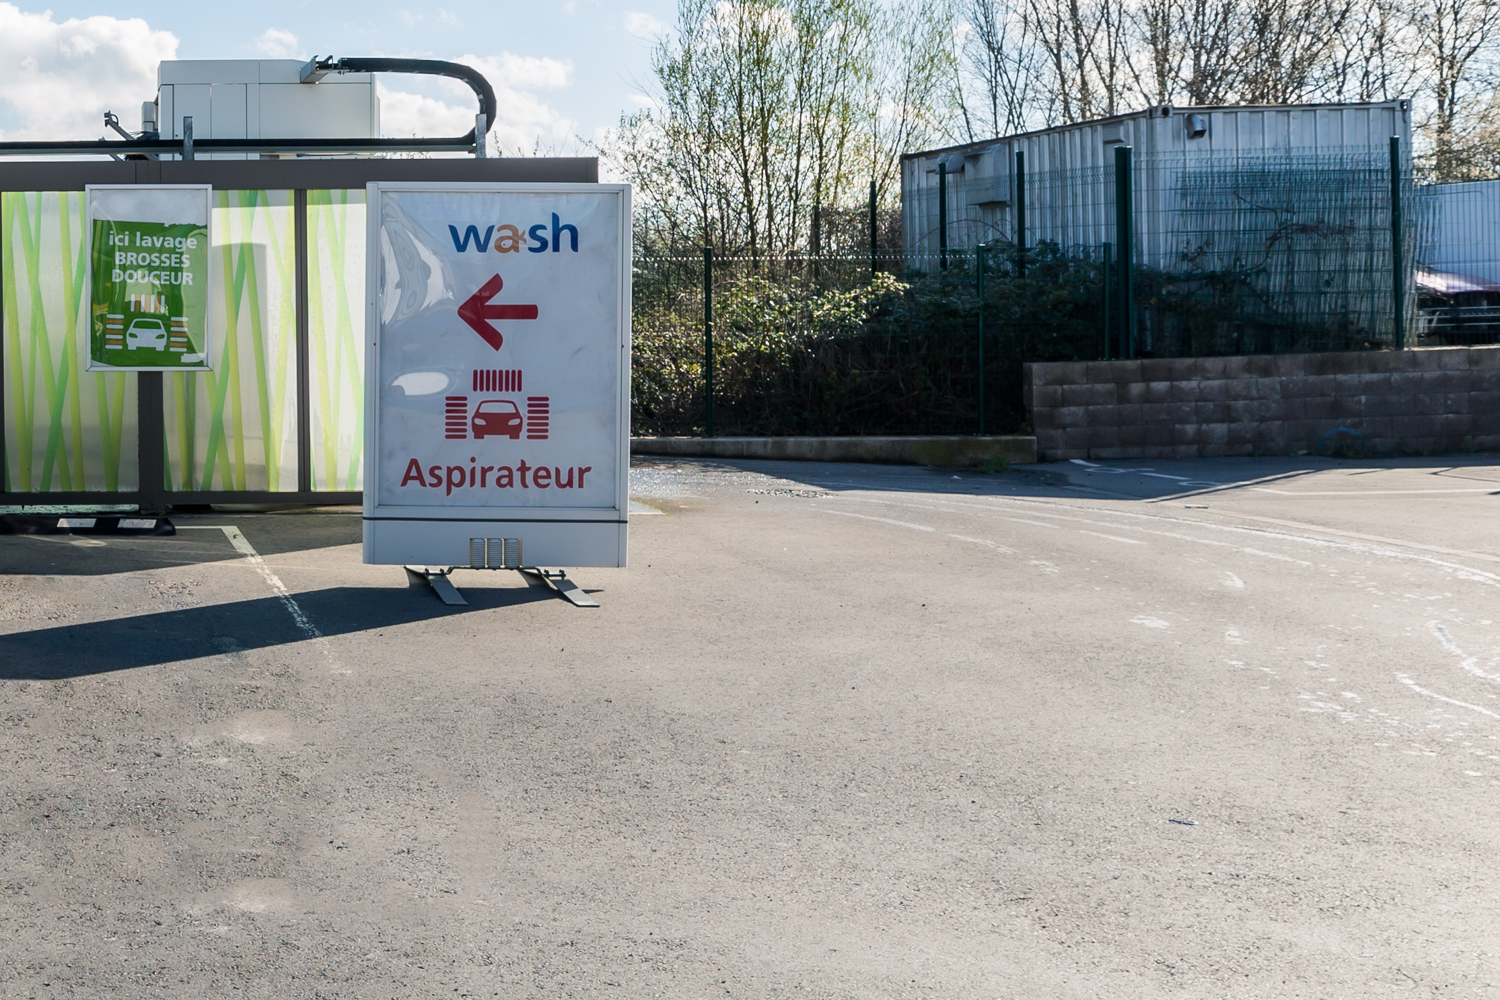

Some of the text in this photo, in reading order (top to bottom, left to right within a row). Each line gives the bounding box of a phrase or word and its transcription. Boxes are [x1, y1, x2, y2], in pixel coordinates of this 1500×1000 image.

[109, 231, 197, 252] ici lavage
[448, 212, 579, 253] wash
[115, 252, 190, 268] BROSSES
[112, 270, 193, 285] DOUCEUR
[400, 456, 592, 496] Aspirateur
